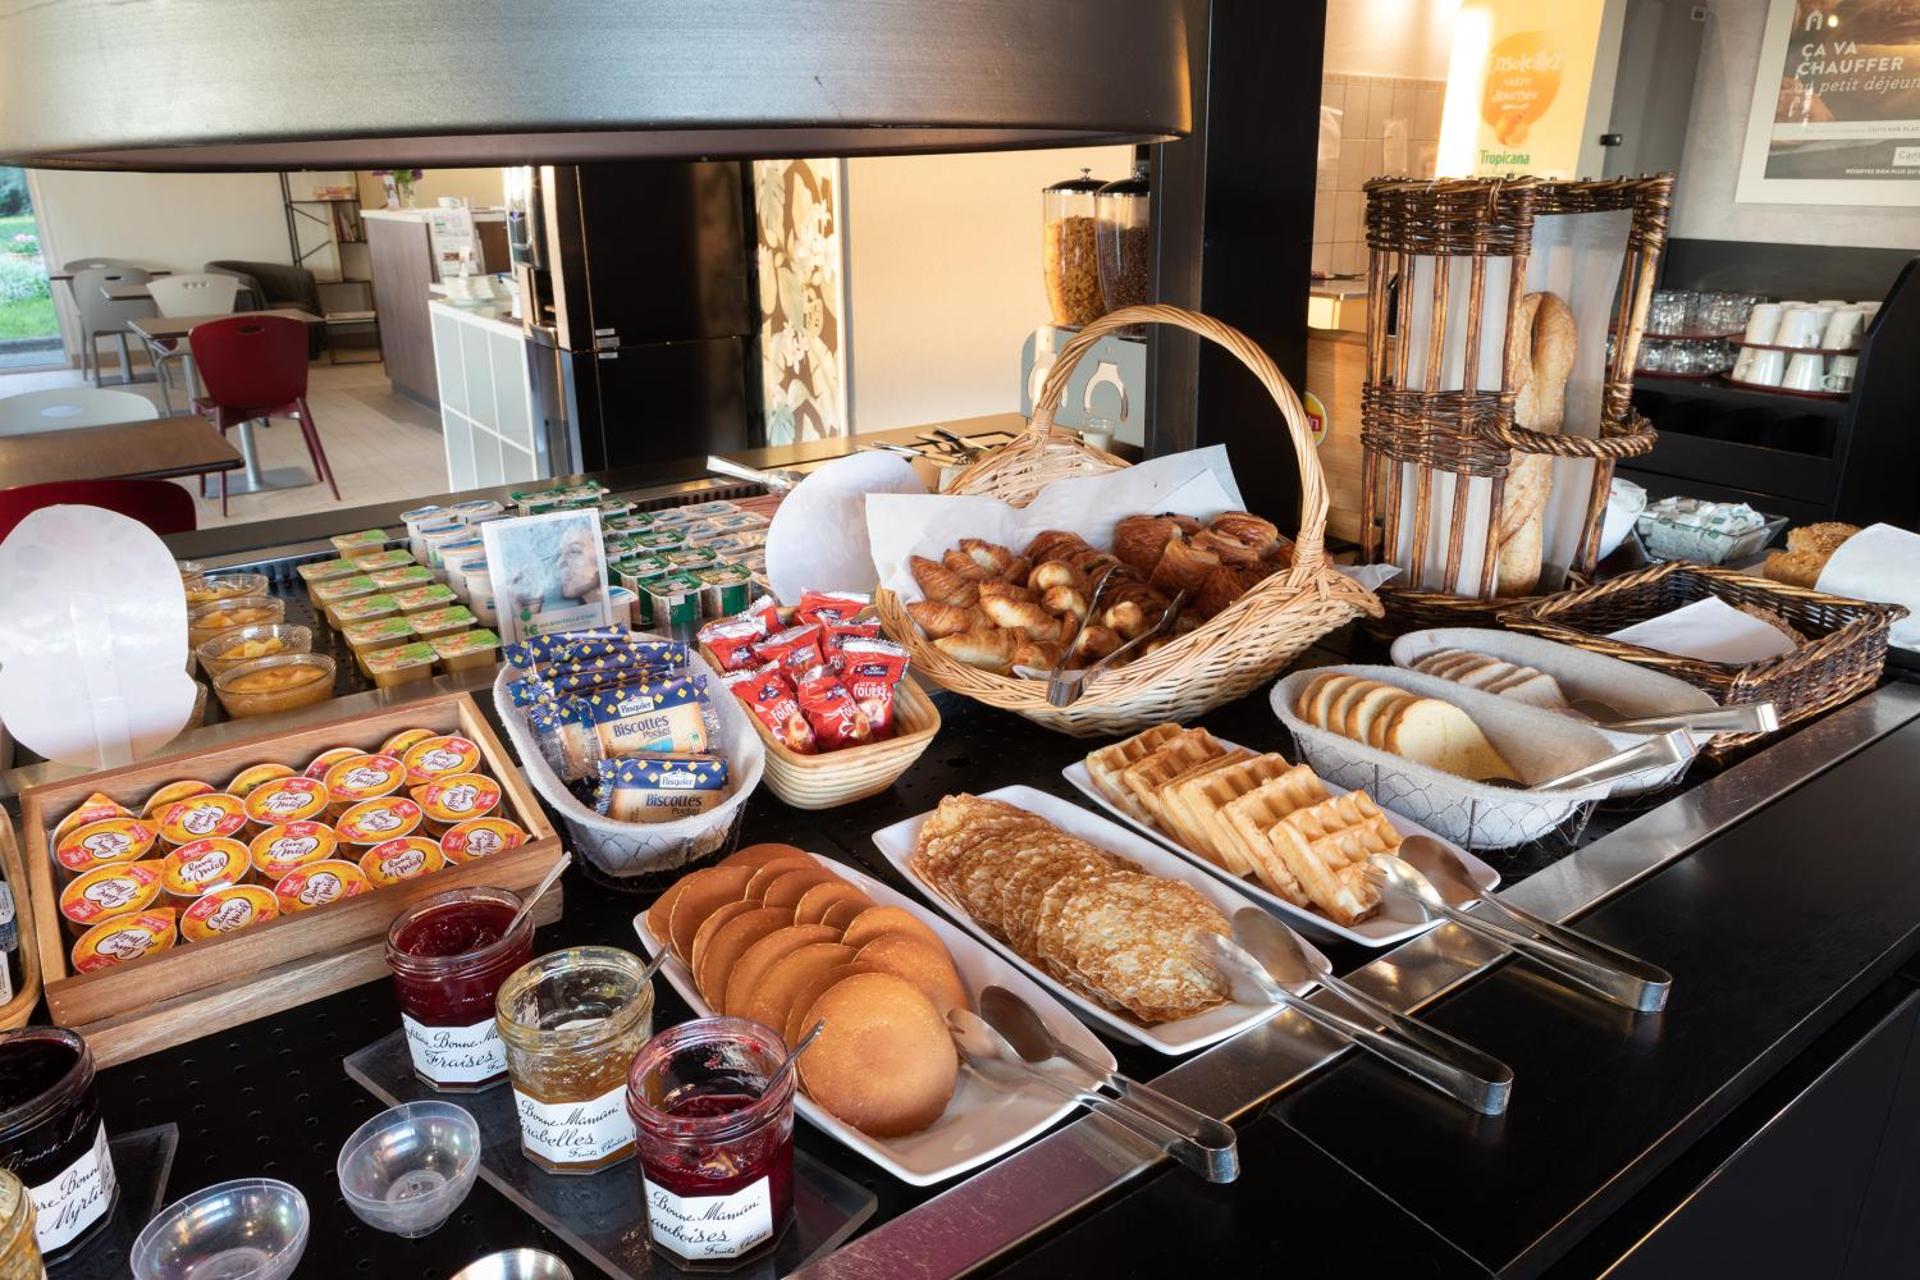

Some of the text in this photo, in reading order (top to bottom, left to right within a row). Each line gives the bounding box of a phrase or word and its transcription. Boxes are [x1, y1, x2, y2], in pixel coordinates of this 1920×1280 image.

[1801, 41, 1857, 61] ÇA VA
[1797, 57, 1904, 76] CHAUFFER
[1819, 78, 1859, 94] petit
[1480, 150, 1530, 166] Tropicana
[620, 700, 652, 714] Pasquier
[612, 715, 670, 738] Biscottes
[661, 777, 692, 787] Pasquier
[645, 793, 703, 808] Biscottes
[434, 1031, 479, 1048] Bonne
[425, 1050, 497, 1068] Fraises
[521, 1100, 620, 1126] Bonne Maman
[520, 1119, 596, 1148] irabelles
[60, 1168, 101, 1199] Bonn
[653, 1190, 761, 1221] Bonne Maman
[649, 1217, 729, 1244] amboises
